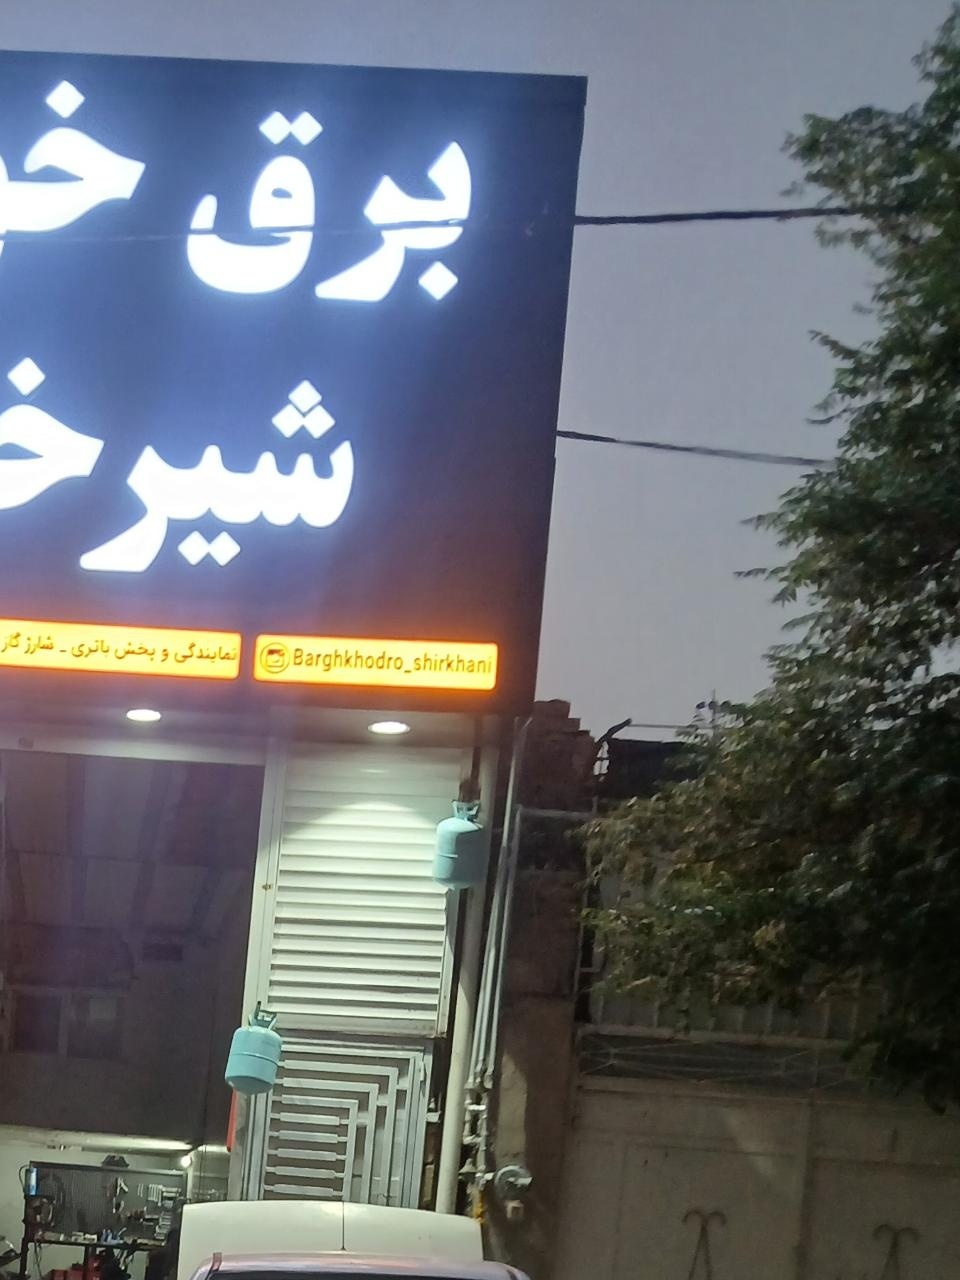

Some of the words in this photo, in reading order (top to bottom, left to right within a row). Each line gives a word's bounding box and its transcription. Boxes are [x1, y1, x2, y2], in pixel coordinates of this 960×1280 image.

[186, 111, 472, 302] برق
[71, 639, 110, 660] باتری
[160, 647, 170, 663] و
[174, 641, 238, 664] نمایندگی
[292, 647, 493, 674] Barghkhodro_shirkhani
